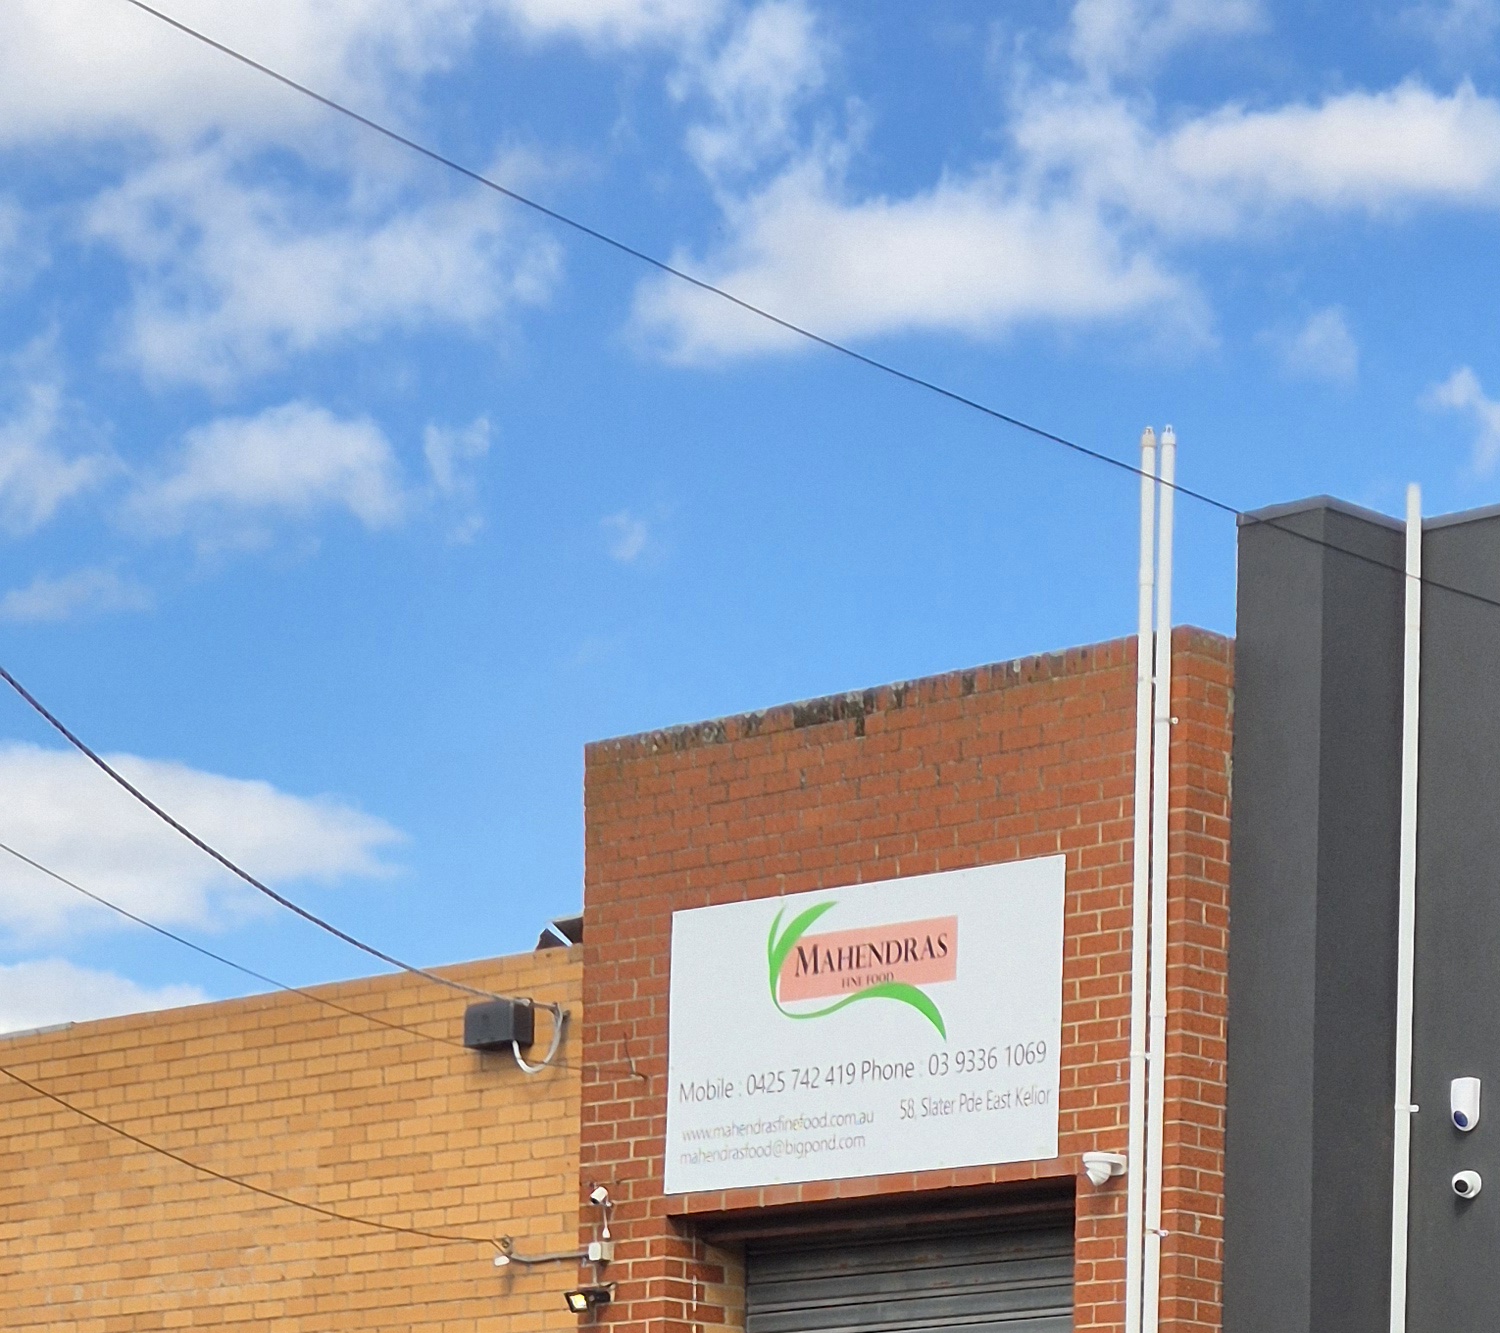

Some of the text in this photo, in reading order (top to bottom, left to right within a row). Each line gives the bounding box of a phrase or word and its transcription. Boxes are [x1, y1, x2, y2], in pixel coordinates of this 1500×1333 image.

[794, 932, 949, 978] MAHENDRAS
[679, 1078, 734, 1103] Mobile
[746, 1070, 786, 1097] 0425
[791, 1066, 821, 1091] 742
[825, 1062, 857, 1086] 419
[861, 1057, 915, 1083] Phone
[928, 1052, 949, 1077] 03
[955, 1046, 998, 1074] 9336
[1005, 1040, 1047, 1067] 1069
[921, 1096, 955, 1118] Slater
[959, 1091, 983, 1114] Pde
[986, 1088, 1011, 1112] East
